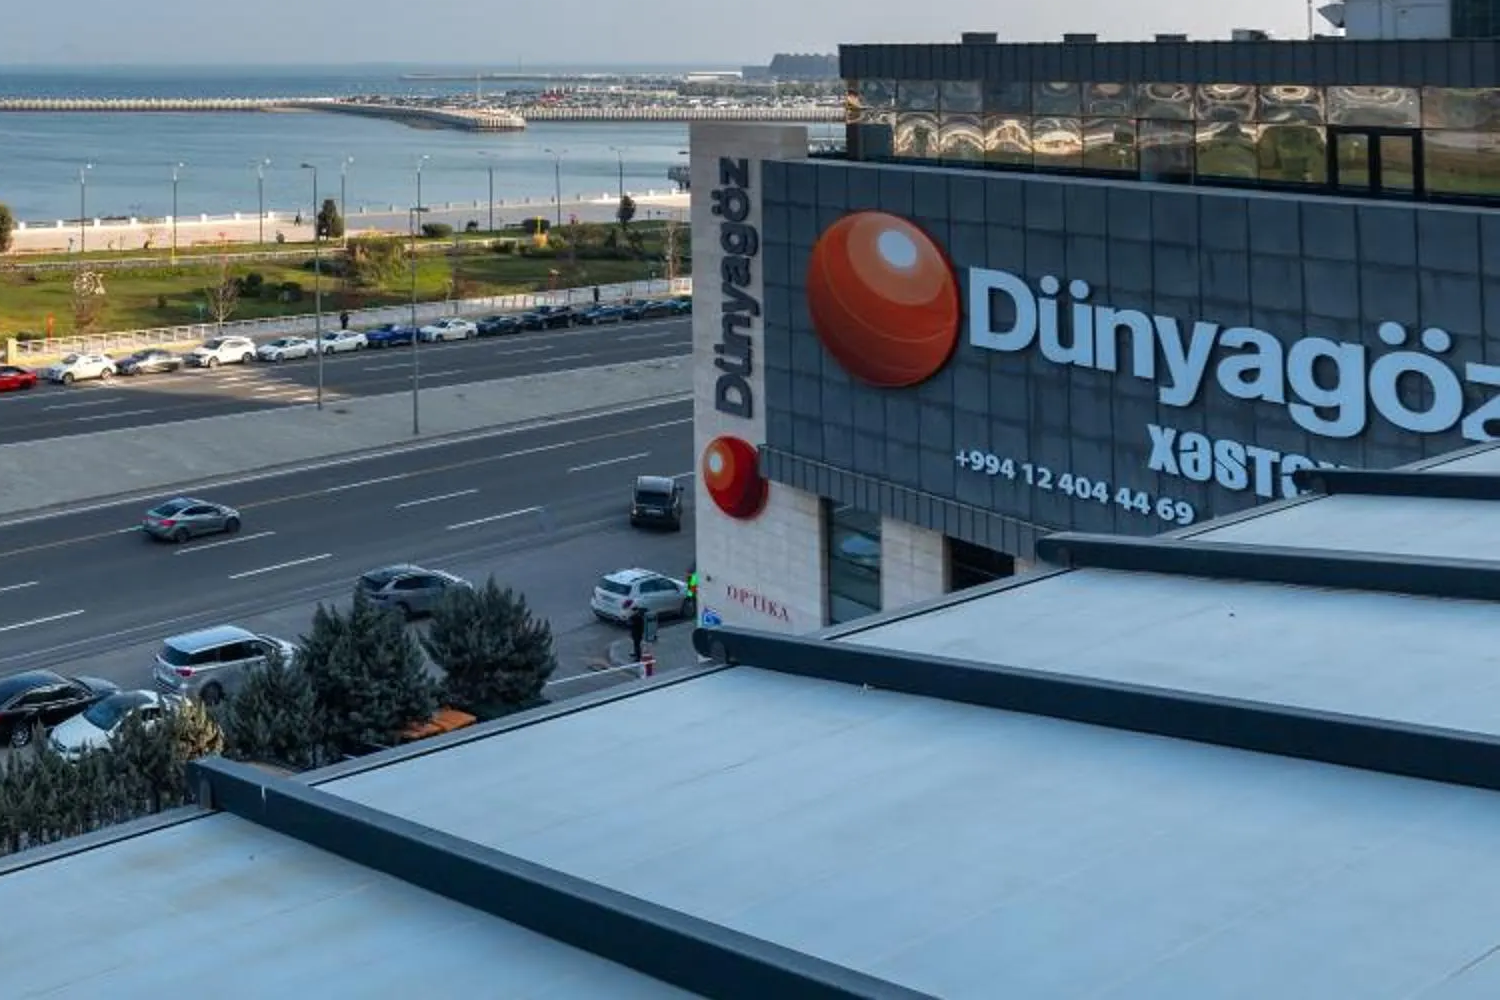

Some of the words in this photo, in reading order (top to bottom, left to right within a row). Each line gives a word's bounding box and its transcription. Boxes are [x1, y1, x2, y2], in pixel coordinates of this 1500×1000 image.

[711, 157, 761, 420] Dünyagöz
[955, 447, 1016, 480] +994
[1021, 462, 1053, 489] 12
[1058, 472, 1109, 504] 404
[1114, 487, 1151, 515] 44
[1155, 497, 1195, 525] 69
